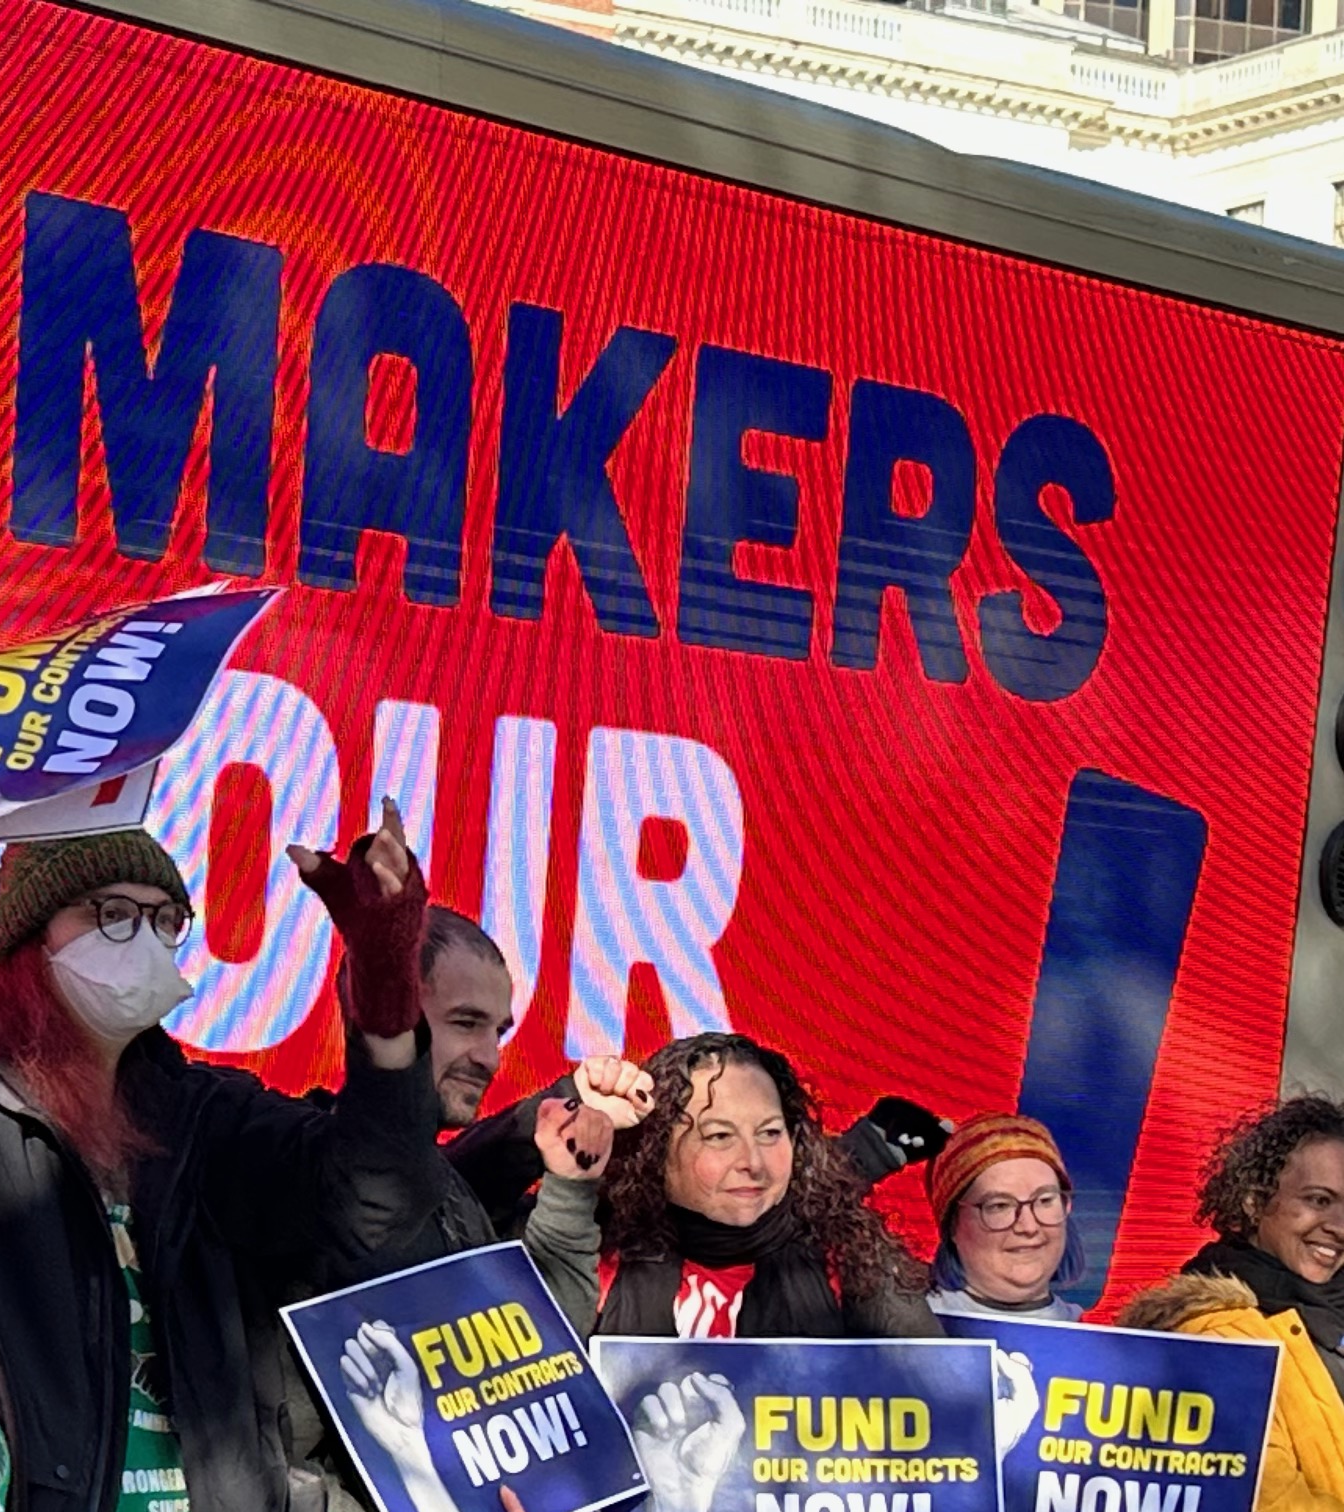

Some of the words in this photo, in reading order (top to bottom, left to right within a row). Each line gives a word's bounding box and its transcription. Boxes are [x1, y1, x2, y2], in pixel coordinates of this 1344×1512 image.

[42, 620, 184, 774] NOW!
[6, 711, 52, 771] OUR
[411, 1302, 543, 1390] FUND
[436, 1387, 481, 1422] OUR
[479, 1350, 584, 1406] CONTRACTS
[1044, 1376, 1216, 1446] FUND
[451, 1391, 588, 1488] NOW!
[754, 1395, 931, 1452] FUND
[1039, 1436, 1092, 1464] OUR
[1098, 1443, 1247, 1477] CONTRACTS
[753, 1457, 809, 1484] OUR
[821, 1457, 979, 1484] CONTRACTS
